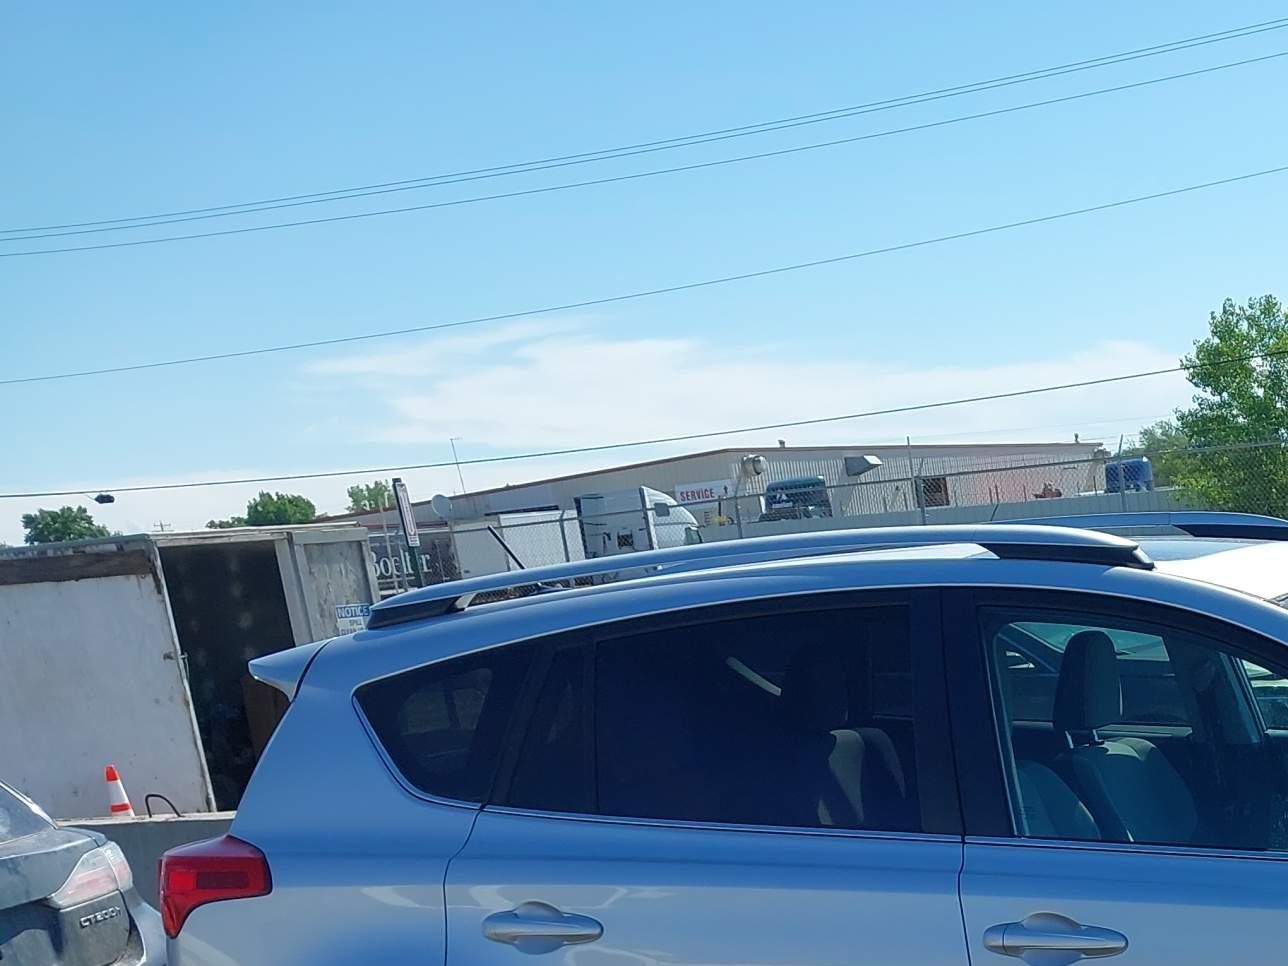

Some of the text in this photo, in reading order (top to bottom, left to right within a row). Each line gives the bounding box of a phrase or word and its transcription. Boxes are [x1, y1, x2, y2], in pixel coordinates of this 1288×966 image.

[680, 488, 715, 502] SERVICE
[370, 548, 432, 577] Boeltr
[337, 606, 369, 618] NOTICE
